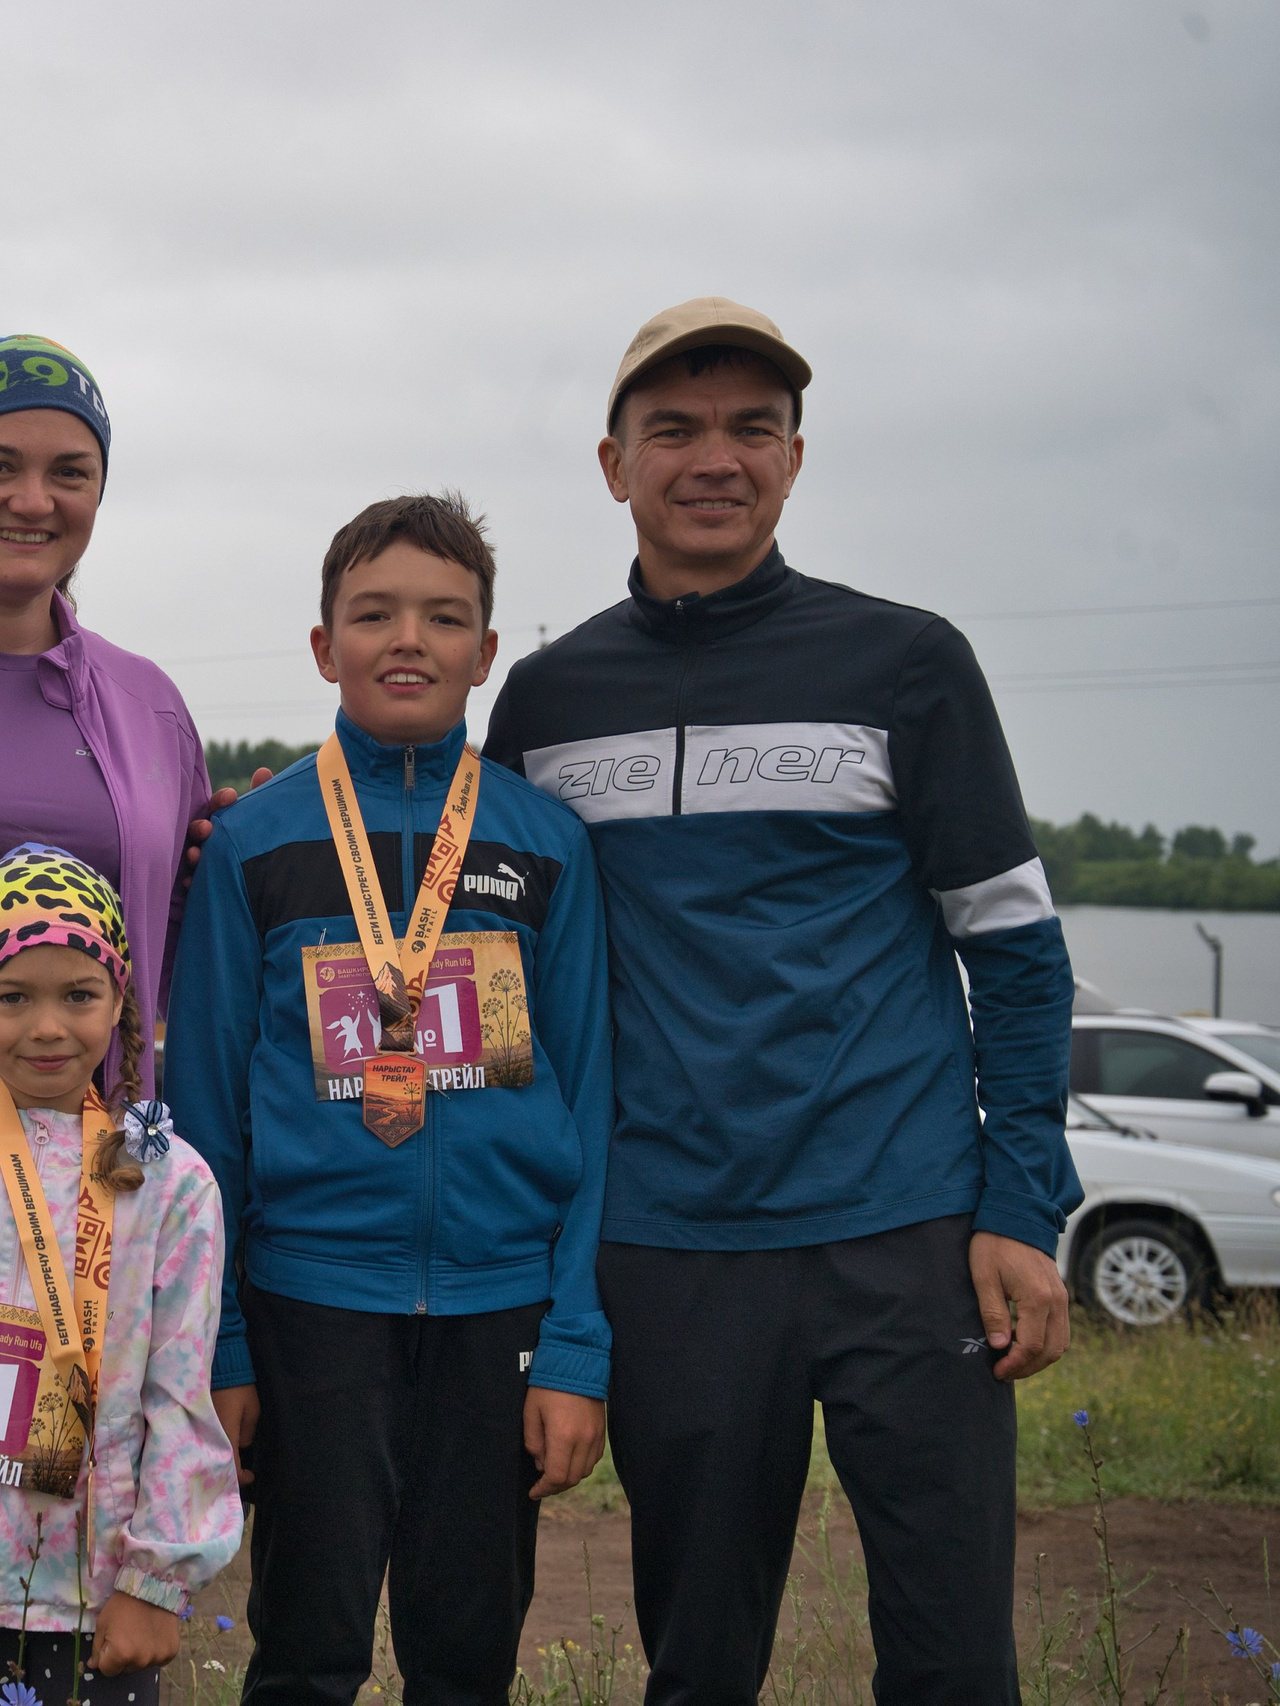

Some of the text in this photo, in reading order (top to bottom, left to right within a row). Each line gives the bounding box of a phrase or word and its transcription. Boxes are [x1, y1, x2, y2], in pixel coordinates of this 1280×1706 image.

[465, 771, 473, 784] Ufa
[558, 745, 866, 801] zie ner
[332, 778, 384, 945] БЕГИ НАВСТРЕЧУ СВОИМ ВЕРШИНАМ
[463, 874, 519, 901] PUMA
[415, 907, 431, 938] BASH
[424, 910, 437, 938] TRAIL
[430, 957, 471, 969] ady Run Ufa
[373, 1065, 417, 1073] НАРЫСТАУ
[382, 1074, 407, 1082] ТРЕЙЛ
[10, 1153, 69, 1346] БЕГИ НАВСТРЕЧУ СВОИМ ВЕРШИНАМ
[83, 1300, 93, 1335] BASH
[14, 1336, 29, 1348] Run
[30, 1339, 43, 1351] Ufa
